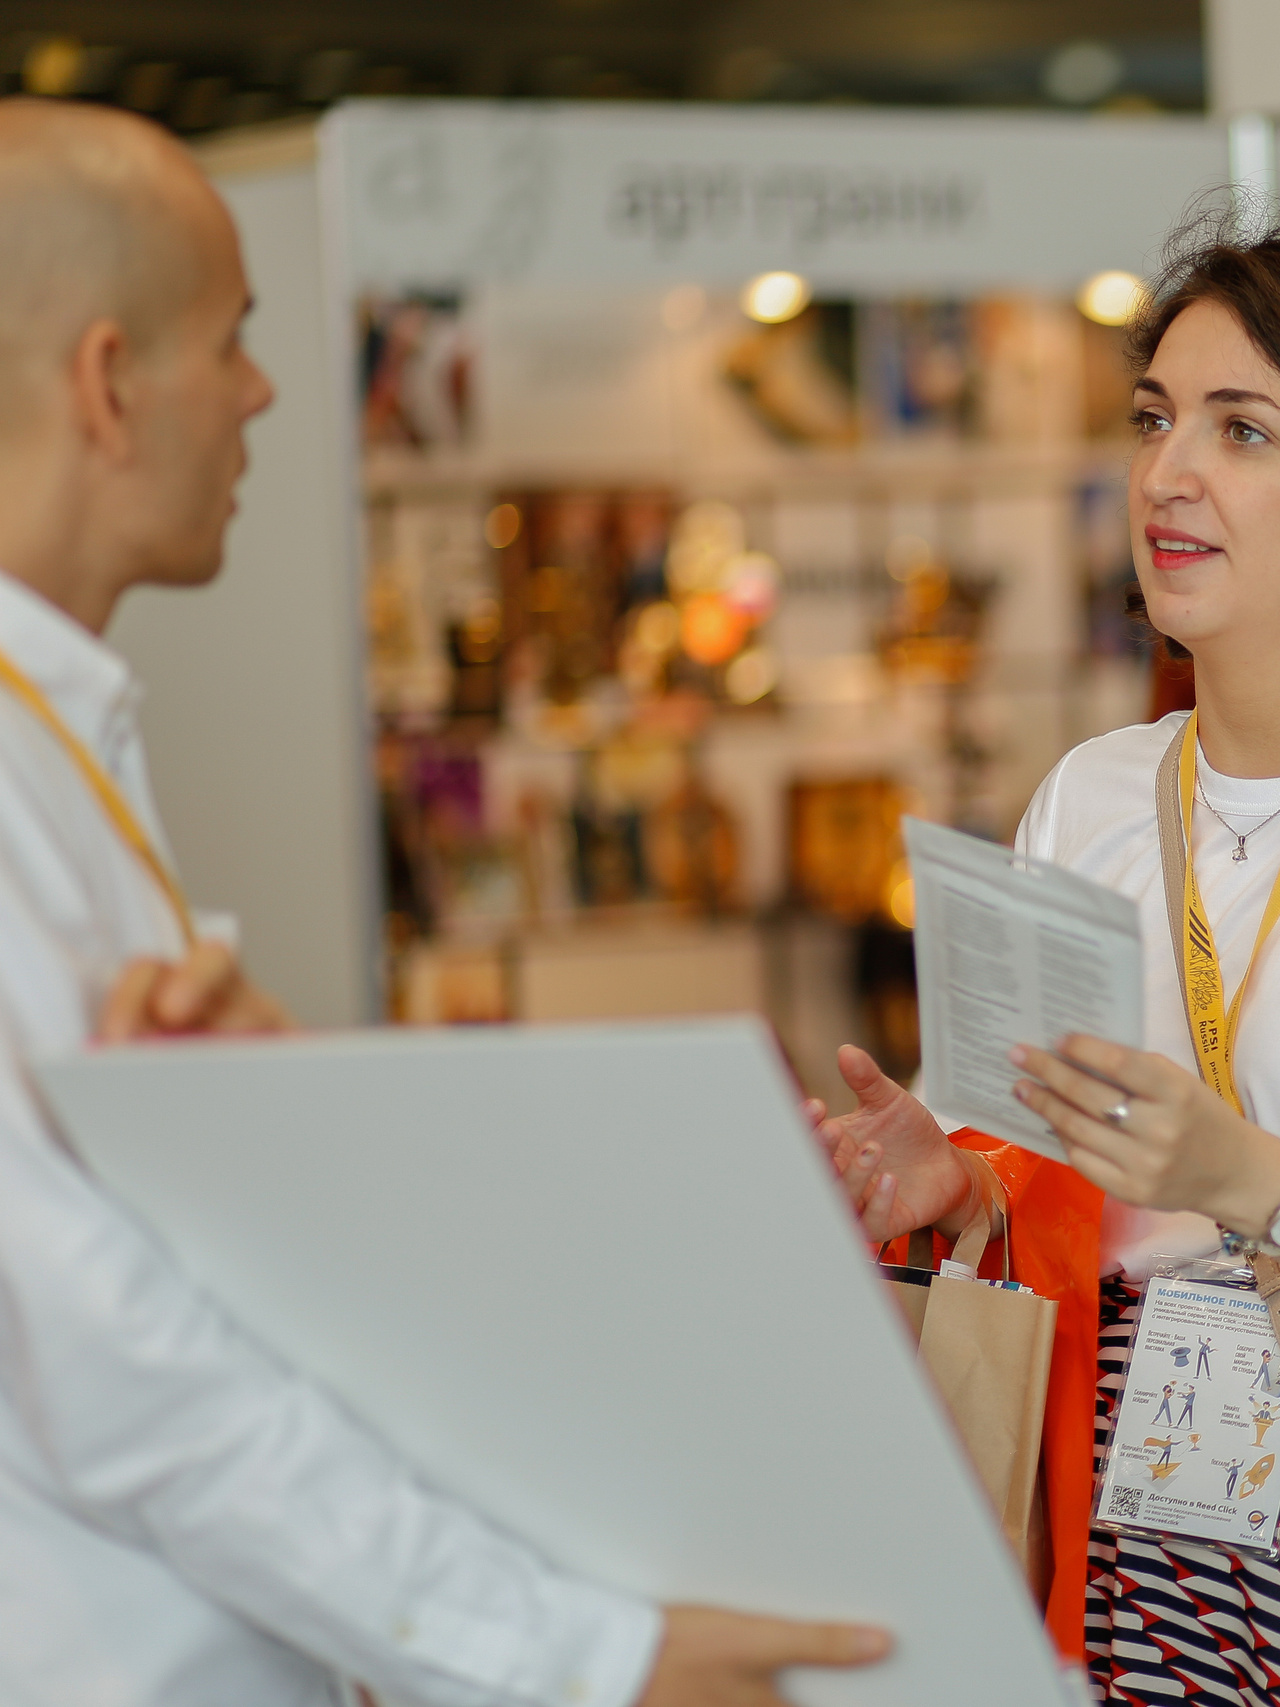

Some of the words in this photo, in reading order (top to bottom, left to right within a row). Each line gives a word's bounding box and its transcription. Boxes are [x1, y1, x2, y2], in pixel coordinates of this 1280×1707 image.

[1198, 1020, 1211, 1054] Russia
[1208, 1027, 1218, 1051] PSI
[1156, 1288, 1226, 1305] МОБИЛЬНОЕ
[1228, 1299, 1269, 1313] ПРИЛО
[1207, 1314, 1222, 1322] Reed
[1219, 1309, 1248, 1319] Exhibitions
[1249, 1314, 1268, 1322] Russia
[1147, 1493, 1188, 1507] Доступно
[1196, 1502, 1217, 1511] Reed
[1218, 1505, 1238, 1515] Click
